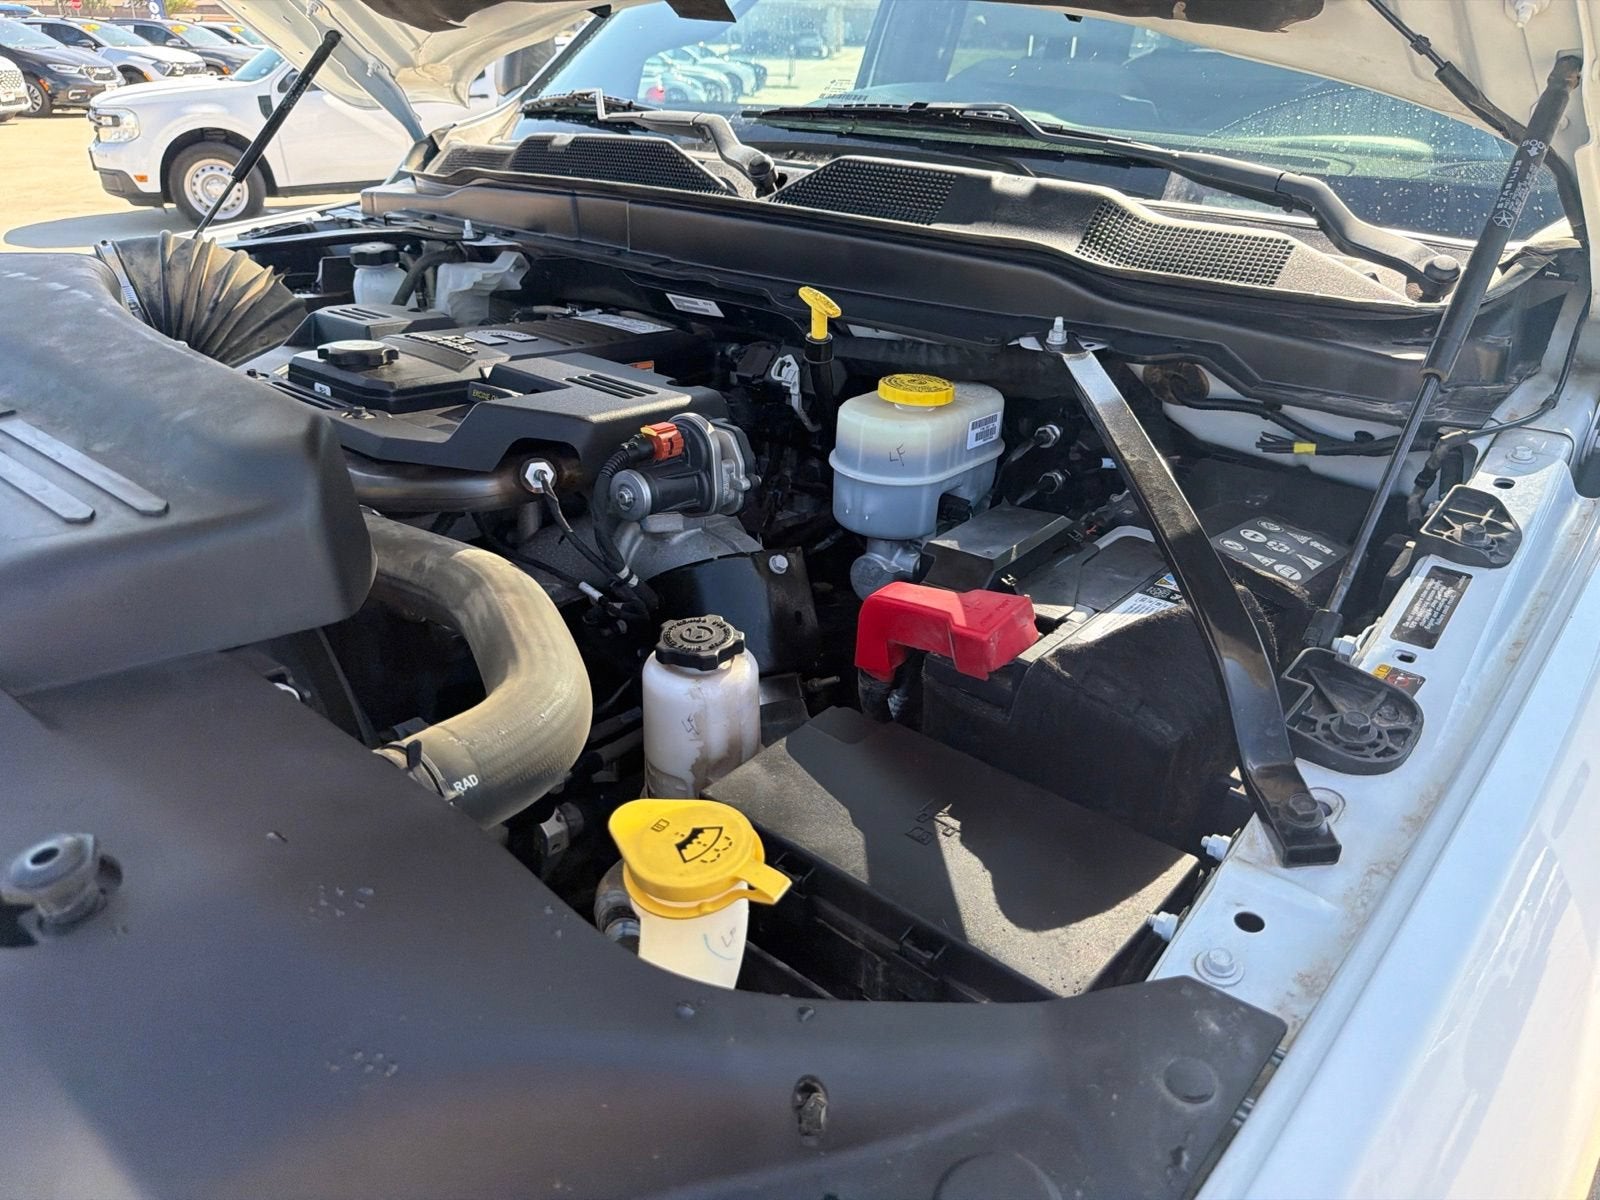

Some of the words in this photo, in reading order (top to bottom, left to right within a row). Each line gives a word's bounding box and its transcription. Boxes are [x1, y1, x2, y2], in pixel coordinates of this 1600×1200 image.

[1496, 160, 1522, 209] STABILUS
[889, 443, 905, 467] LF
[453, 774, 479, 792] RAD
